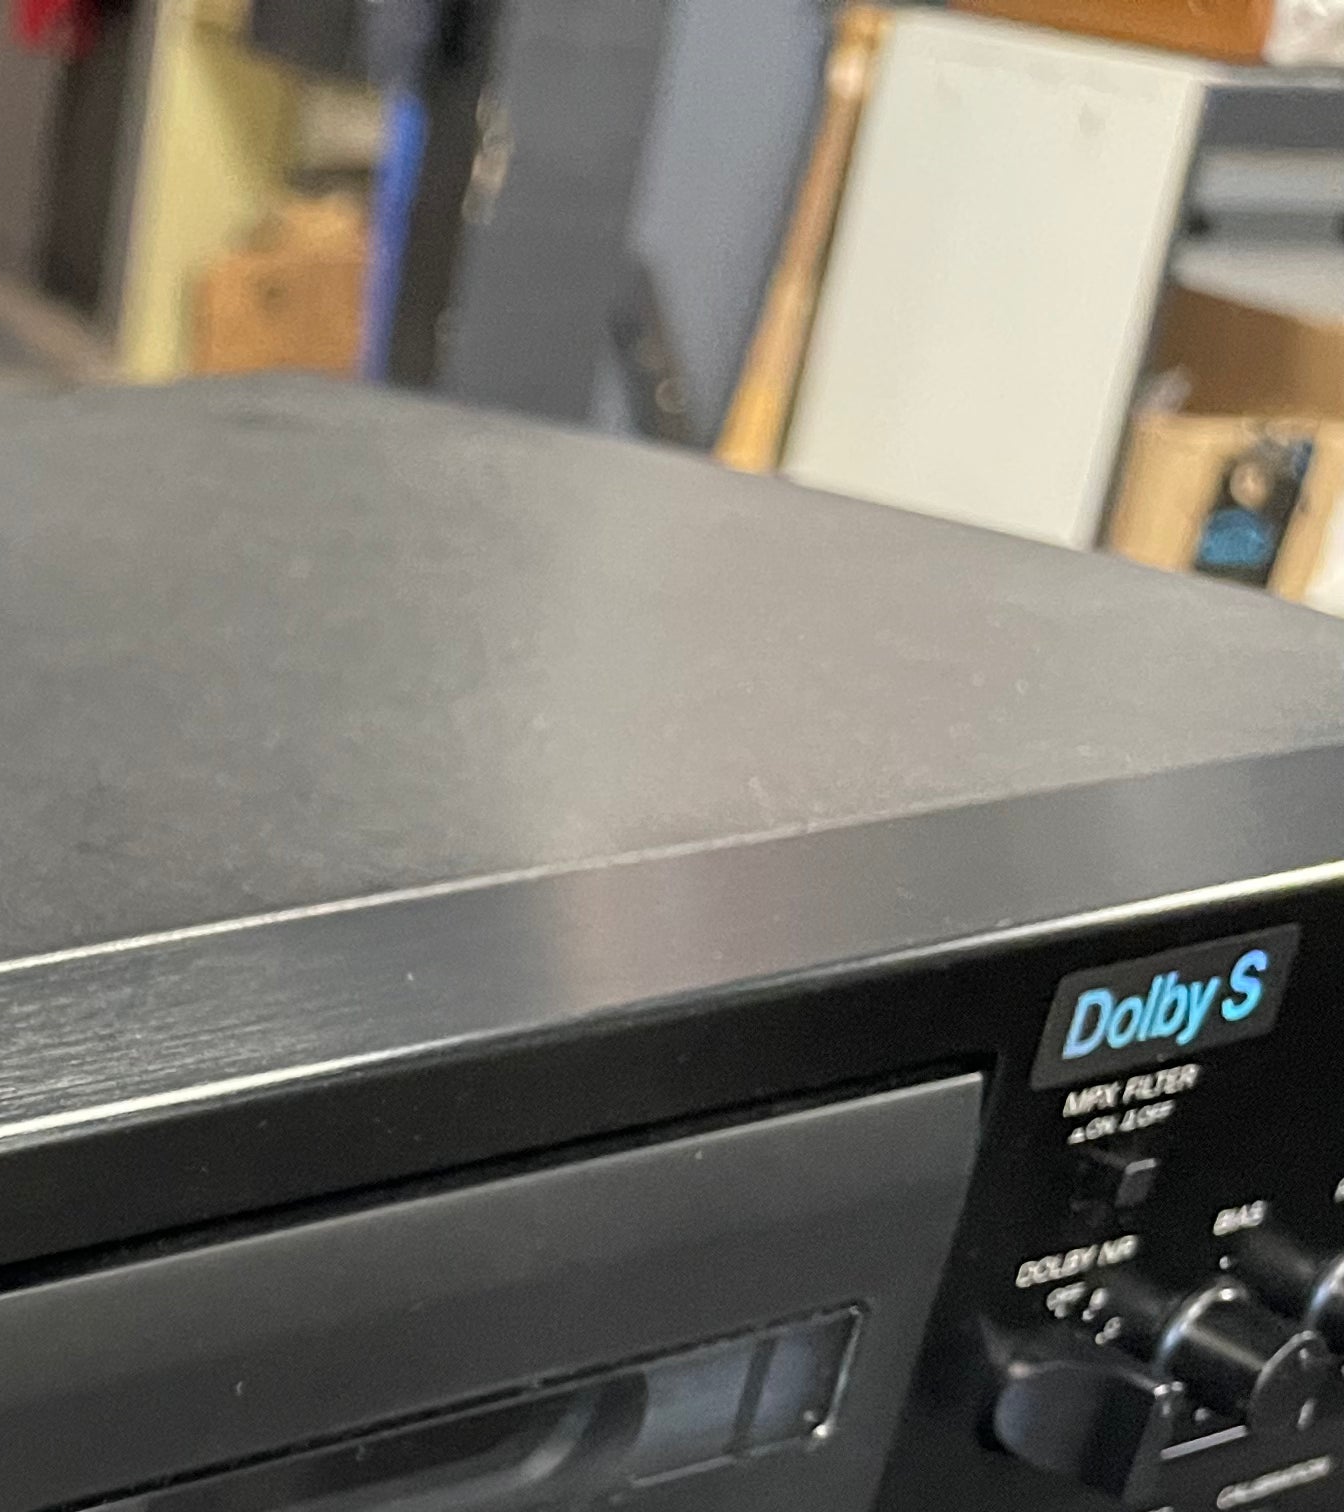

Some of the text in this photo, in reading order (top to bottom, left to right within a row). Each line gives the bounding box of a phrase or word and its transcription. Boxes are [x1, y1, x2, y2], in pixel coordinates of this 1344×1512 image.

[1062, 949, 1268, 1060] Dolby S
[1016, 1244, 1099, 1289] DOLBY
